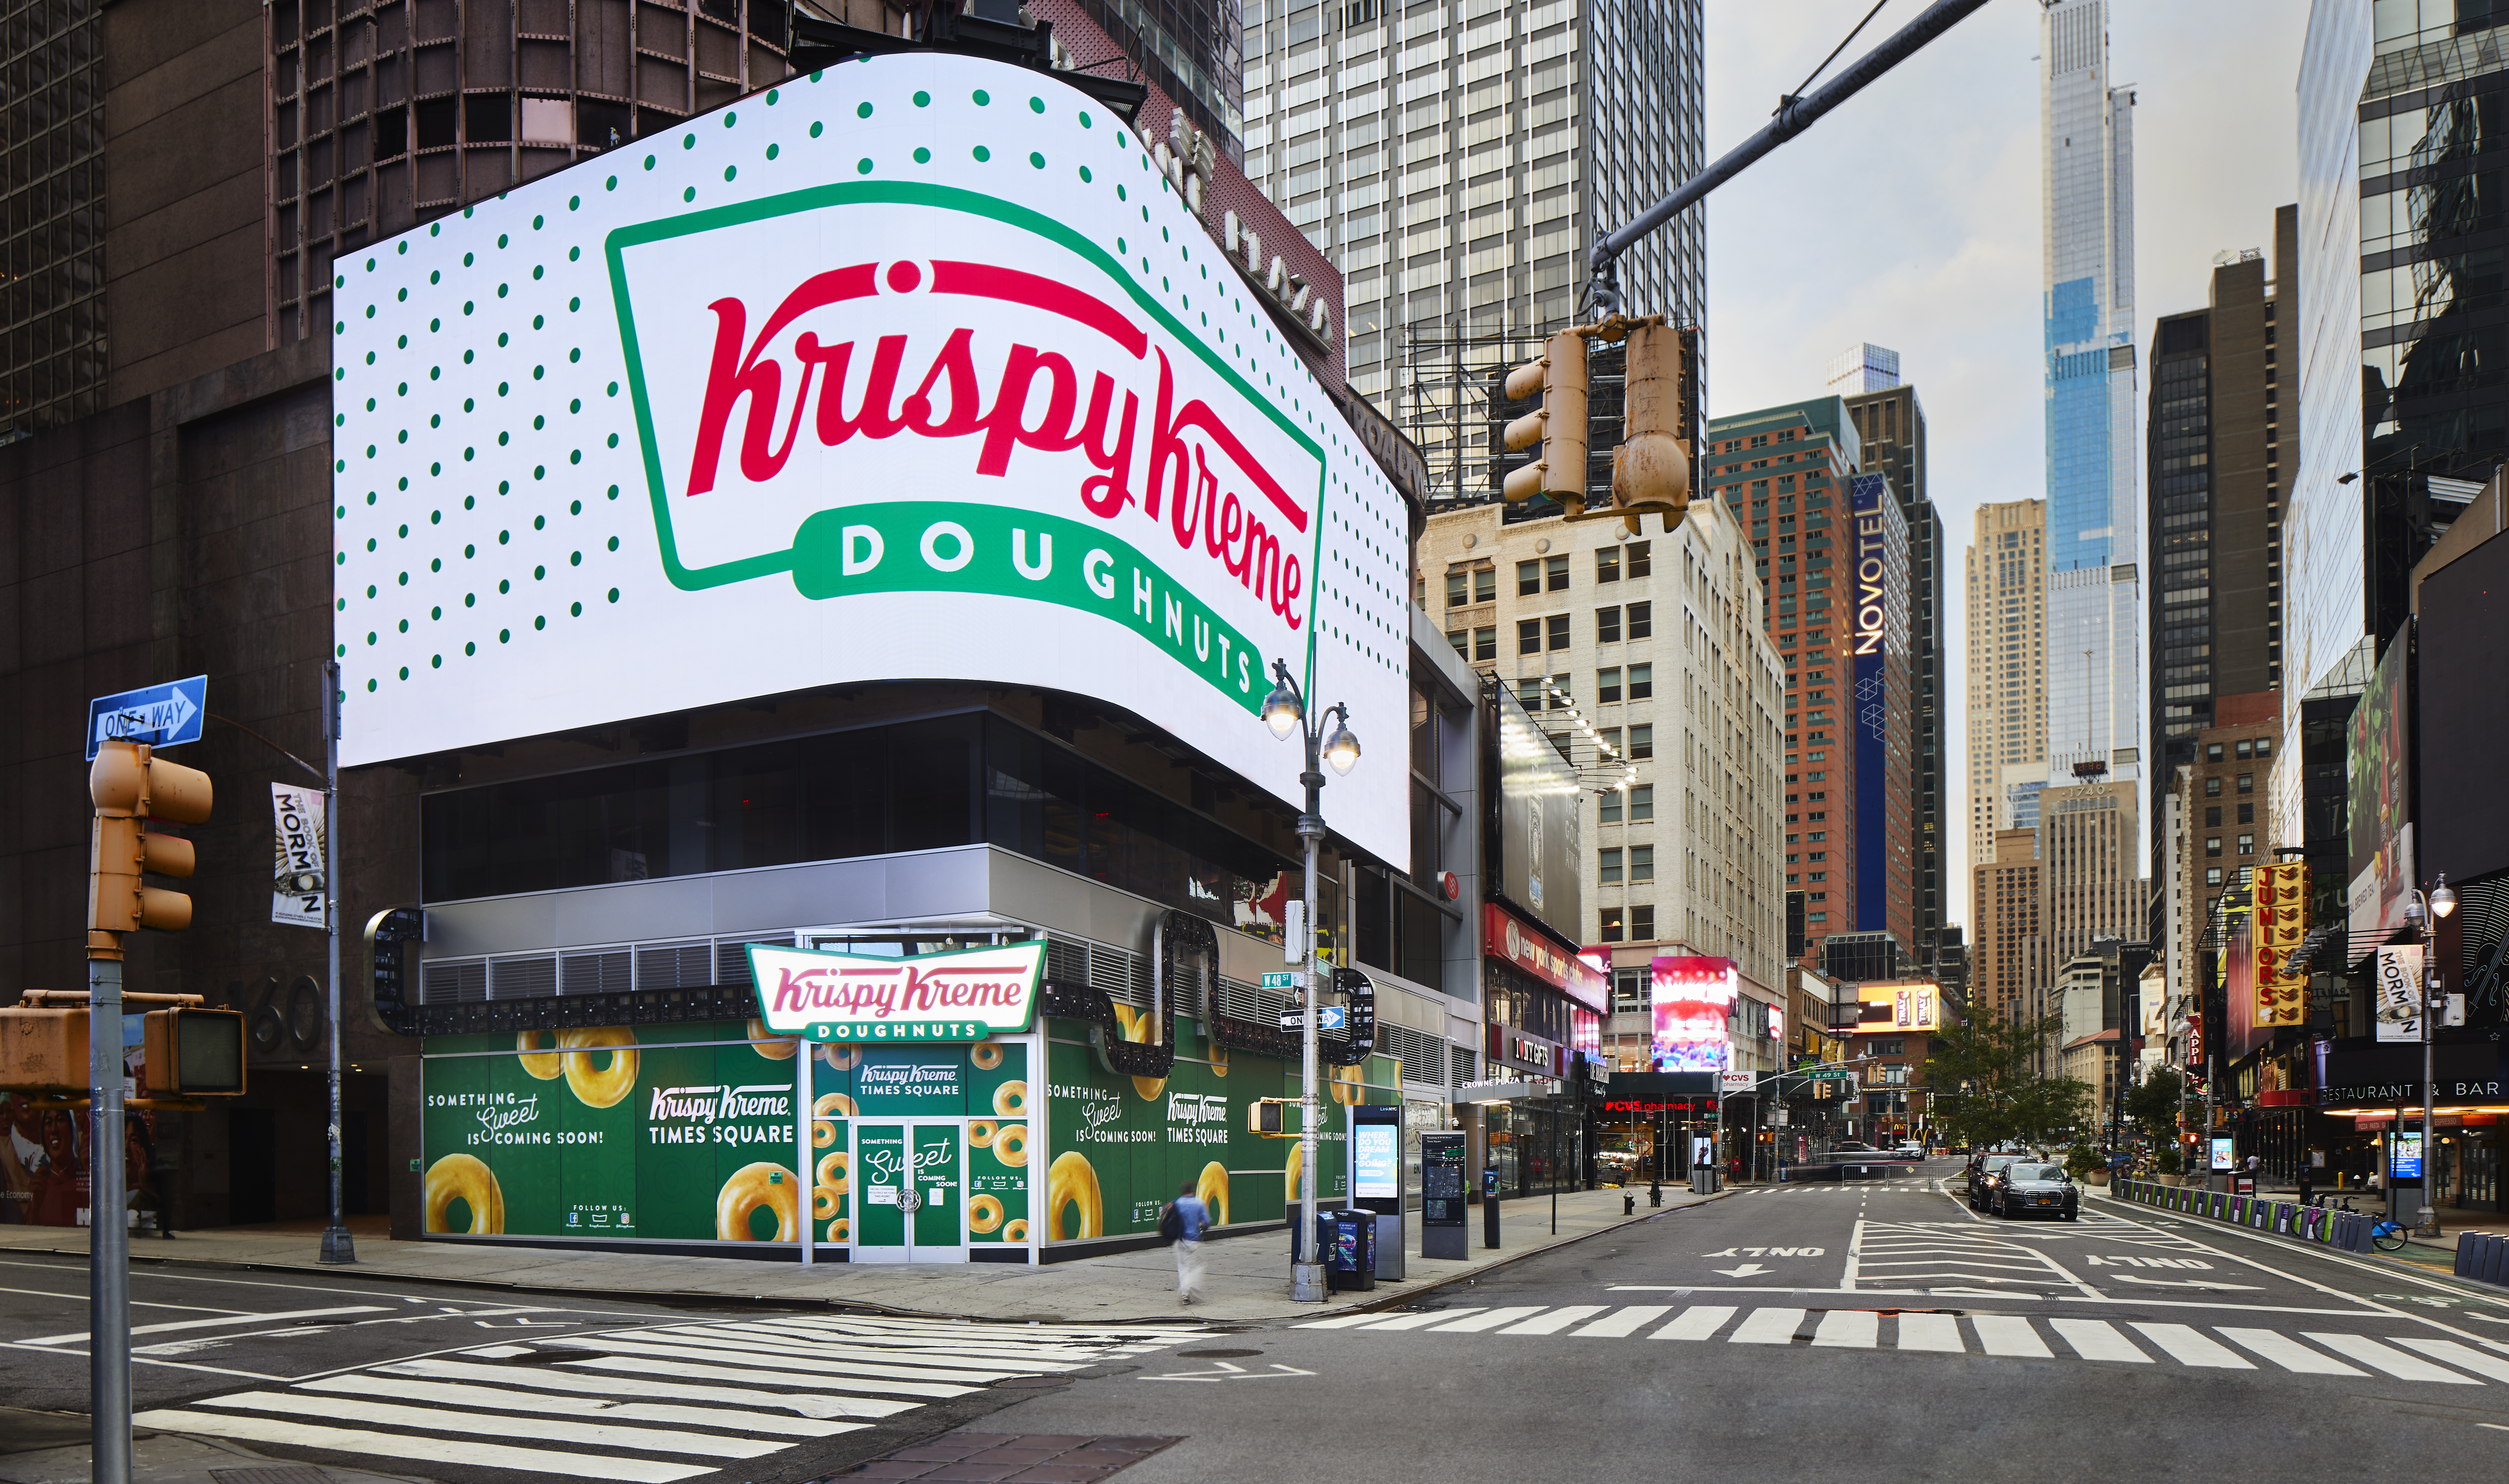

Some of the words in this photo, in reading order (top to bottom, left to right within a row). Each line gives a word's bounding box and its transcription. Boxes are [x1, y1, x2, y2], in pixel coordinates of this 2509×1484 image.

[1225, 210, 1334, 342] PLAZA
[686, 260, 1148, 519] Krispy
[1145, 344, 1308, 630] Kreme
[1854, 493, 1884, 655] NOVOTEL
[842, 521, 1249, 693] DOUGHNUTS
[105, 710, 137, 737] ONE
[152, 700, 186, 728] WAY
[1565, 793, 1577, 822] THE
[293, 793, 306, 813] THE
[301, 818, 315, 850] BOOK
[310, 852, 319, 867] OF
[1565, 847, 1581, 877] AWA
[2258, 867, 2274, 1005] JUNIORS
[1521, 936, 1535, 961] new
[1536, 946, 1549, 970] york
[1551, 954, 1568, 980] sports
[1569, 962, 1583, 988] clubs
[1264, 975, 1271, 986] W
[1271, 974, 1281, 986] 48
[2395, 950, 2405, 965] THE
[2400, 967, 2412, 989] BOOK
[2408, 990, 2416, 1000] OF
[772, 966, 903, 1018] Krispy
[900, 965, 1028, 1011] Kreme
[818, 1023, 975, 1038] DOUGHNUTS
[1290, 1016, 1304, 1025] ON
[1317, 1014, 1334, 1023] WAY
[1516, 1037, 1519, 1059] I
[1524, 1040, 1534, 1062] NY
[1534, 1043, 1548, 1067] GIFTS
[860, 1065, 911, 1085] Krispy
[909, 1065, 958, 1082] Kreme
[1462, 1079, 1493, 1089] CROWNE
[1496, 1076, 1520, 1085] PLAZA
[428, 1093, 515, 1106] SOMETHING
[860, 1085, 900, 1094] TIMES
[905, 1085, 959, 1097] SQUARE
[1048, 1084, 1107, 1100] SOMETHING
[2323, 1084, 2413, 1101] RESTAURANT
[2432, 1084, 2439, 1096] &
[2456, 1082, 2499, 1096] BAR
[649, 1085, 721, 1124] Krispy
[720, 1083, 792, 1118] Kreme
[1167, 1091, 1199, 1127] Krispy
[1198, 1091, 1228, 1122] Kreme
[1615, 1100, 1641, 1111] CVS
[1644, 1101, 1696, 1112] pharmacy
[477, 1093, 539, 1143] Sweet
[1082, 1091, 1121, 1140] Sweet
[2435, 1117, 2457, 1126] ESPRESSO
[468, 1133, 479, 1145] IS
[495, 1132, 551, 1145] COMING
[557, 1131, 603, 1144] SOON!
[649, 1127, 705, 1144] TIMES
[715, 1125, 793, 1147] SQUARE
[1076, 1130, 1085, 1142] IS
[1094, 1130, 1129, 1143] COMING
[1131, 1130, 1156, 1142] SOON!
[1167, 1127, 1193, 1143] TIMES
[1196, 1128, 1228, 1146] SQUARE
[6, 1190, 34, 1201] Economy
[1699, 1246, 1825, 1258] ONLY
[2085, 1255, 2215, 1270] ONLY
